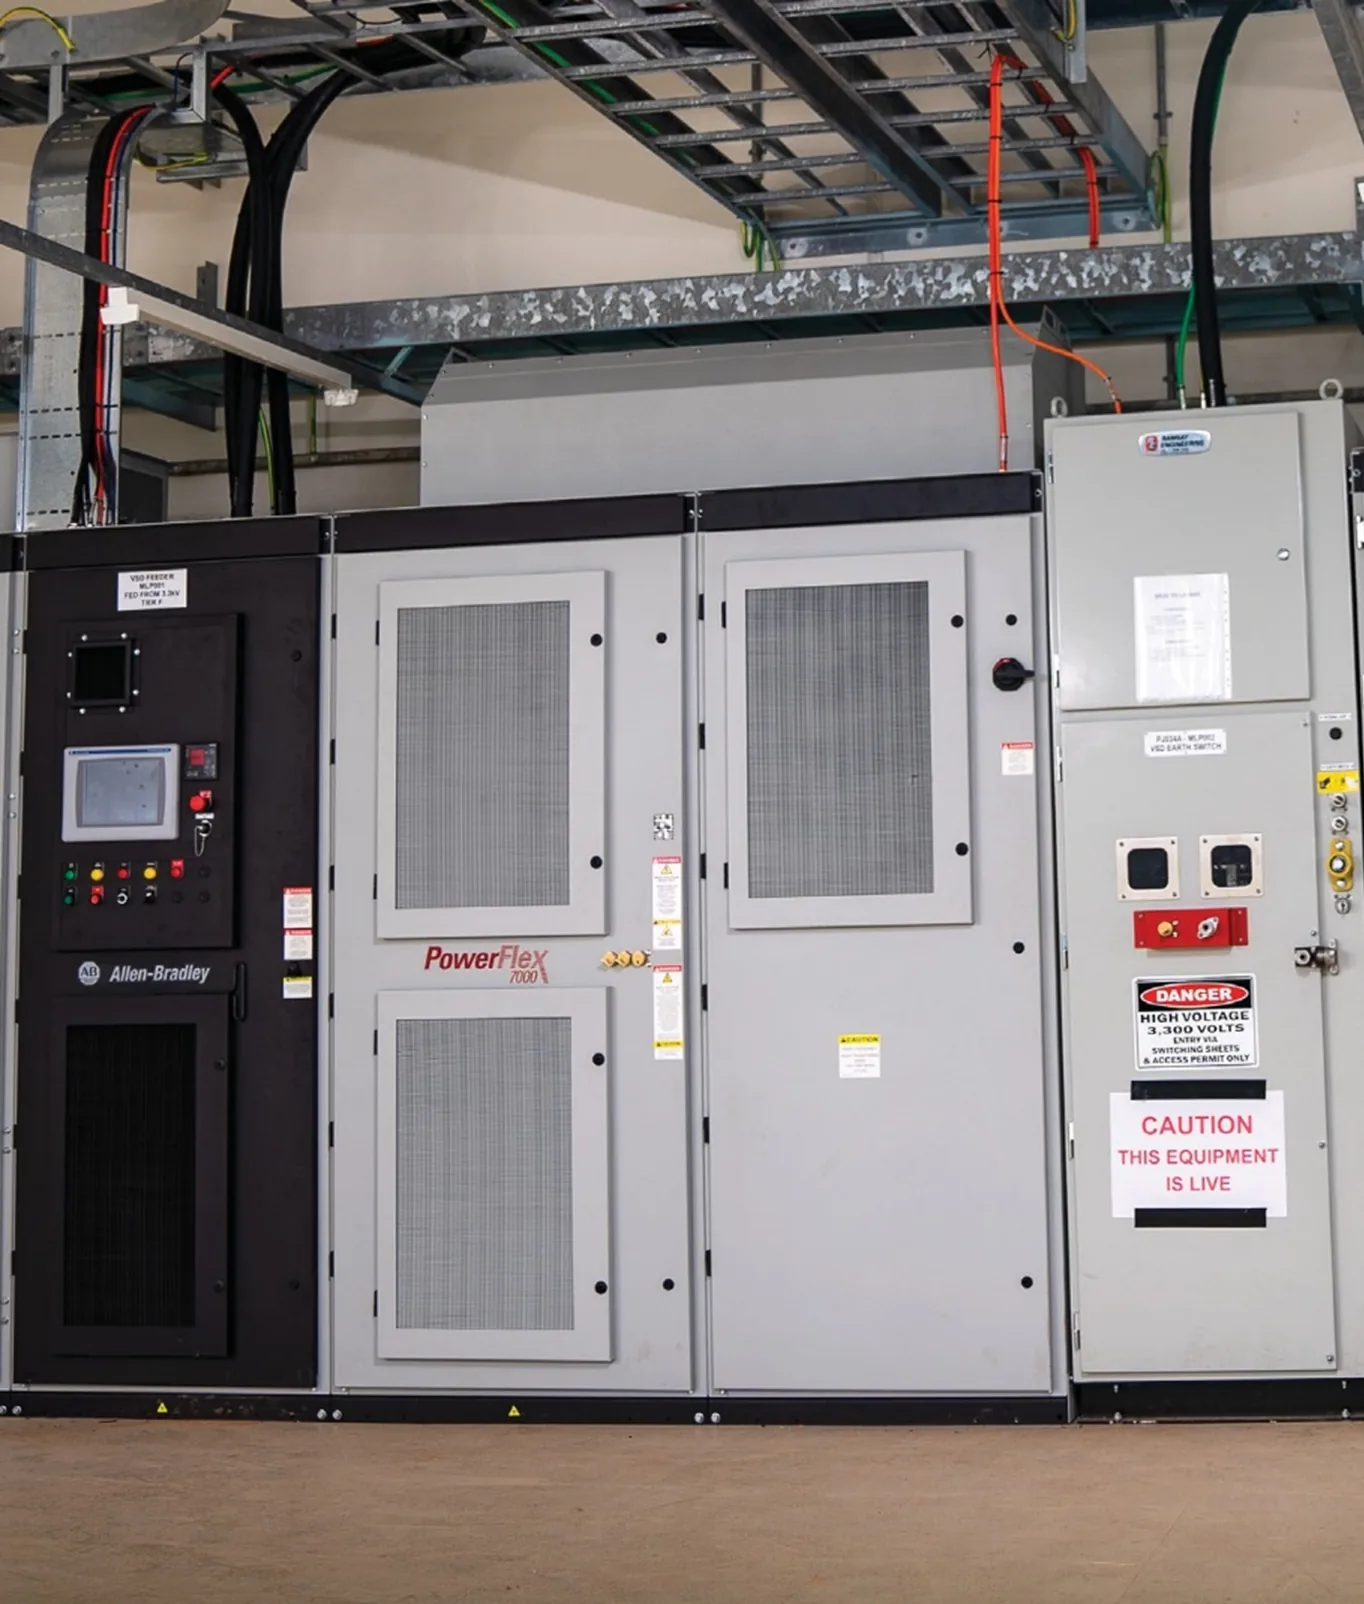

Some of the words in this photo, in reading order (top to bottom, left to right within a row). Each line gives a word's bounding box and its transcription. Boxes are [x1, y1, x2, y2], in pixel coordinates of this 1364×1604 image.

[130, 574, 145, 582] VSD
[124, 591, 138, 599] FED
[140, 590, 160, 598] FROM
[1167, 743, 1191, 751] EARTH
[1194, 742, 1221, 750] SWITCH
[424, 944, 549, 984] PowerFlex
[109, 964, 210, 984] Allen-Bradley
[509, 970, 538, 984] 7000
[1156, 987, 1233, 1002] DANGER
[1140, 1013, 1179, 1023] HIGH
[1182, 1010, 1250, 1022] VOLTAGE
[1197, 1023, 1245, 1034] VOLTS
[1173, 1036, 1201, 1044] ENTRY
[1152, 1045, 1203, 1055] SWITCHING
[1205, 1044, 1240, 1053] SHEETS
[1143, 1057, 1150, 1065] &
[1152, 1056, 1189, 1064] ACCESS
[1190, 1055, 1224, 1063] PERMIT
[1226, 1054, 1250, 1062] ONLY
[1141, 1115, 1253, 1135] CAUTION
[1118, 1149, 1161, 1165] THIS
[1166, 1148, 1279, 1165] EQUIPMENT
[1166, 1176, 1184, 1192] IS
[1190, 1176, 1231, 1191] LIVE
